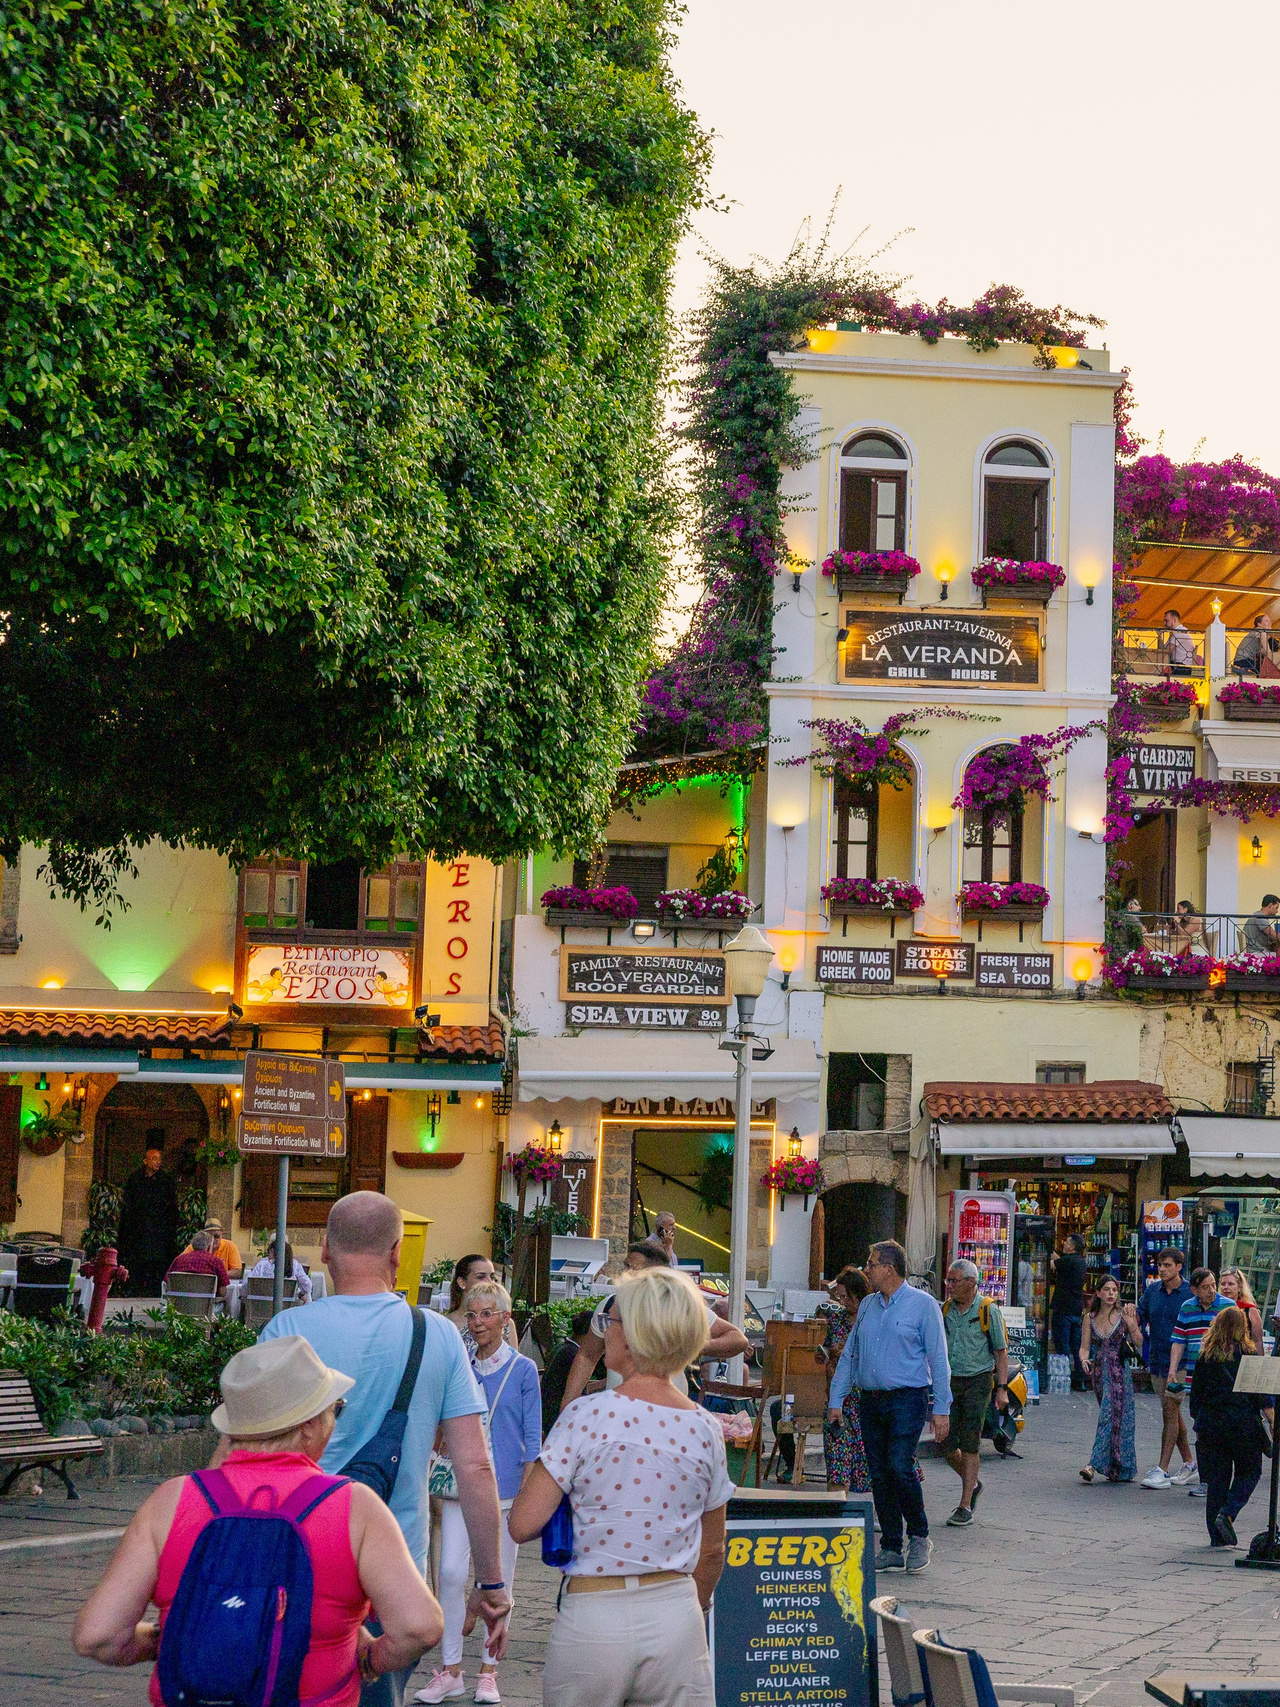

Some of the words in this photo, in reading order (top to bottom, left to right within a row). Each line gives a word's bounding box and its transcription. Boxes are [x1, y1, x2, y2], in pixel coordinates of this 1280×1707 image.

[866, 619, 1013, 650] RESTAURANT-TAVERNA
[861, 644, 893, 662] LA
[902, 645, 1023, 666] VERANDA
[888, 666, 927, 678] GRILL
[951, 668, 997, 681] HOUSE
[1140, 747, 1194, 767] GARDEN
[445, 863, 472, 996] EROS
[282, 946, 379, 962] ΕΣΤΙΑΤΟΡΙΟ
[822, 950, 854, 963] HOME
[859, 951, 890, 965] MADE
[905, 946, 967, 959] STEAK
[571, 956, 622, 974] FAMILY
[634, 956, 724, 978] RESTAURANT
[904, 959, 967, 972] HOUSE
[980, 955, 1017, 967] FRESH
[1024, 956, 1050, 968] FISH
[283, 961, 378, 977] Restaurant
[819, 967, 857, 979] GREEK
[862, 967, 892, 980] FOOD
[593, 971, 614, 982] LA
[621, 972, 700, 984] VERANDA
[979, 973, 1006, 984] SEA
[1014, 973, 1050, 985] FOOD
[284, 976, 376, 1000] EROS
[575, 982, 628, 993] ROOF
[639, 983, 719, 995] GARDEN
[571, 1005, 620, 1024] SEA
[625, 1007, 690, 1026] VIEW
[701, 1010, 720, 1021] 80
[254, 1085, 275, 1096] Ancient
[277, 1088, 288, 1098] and
[289, 1088, 315, 1100] Byzantine
[253, 1099, 287, 1111] Fortification
[288, 1102, 301, 1112] Wall
[613, 1096, 766, 1116] ENTRANE
[243, 1134, 272, 1146] Byzantine
[274, 1135, 309, 1147] Fortification
[309, 1138, 321, 1148] Wall
[562, 1164, 587, 1179] LA
[1008, 1346, 1025, 1355] ACCO
[727, 1534, 851, 1567] BEERS
[760, 1570, 822, 1581] GUINESS
[755, 1583, 827, 1595] HEINEKEN
[762, 1596, 821, 1608] MYTHOS
[768, 1610, 815, 1620] ALPHA
[766, 1623, 818, 1634] BECK'S
[749, 1637, 803, 1648] CHIMAY
[806, 1635, 835, 1646] RED
[745, 1650, 788, 1661] LEFFE
[791, 1649, 840, 1660] BLOND
[770, 1663, 817, 1674] DUVEL
[756, 1676, 831, 1688] PAULANER
[740, 1691, 793, 1702] STELLA
[796, 1689, 847, 1700] ARTOIS
